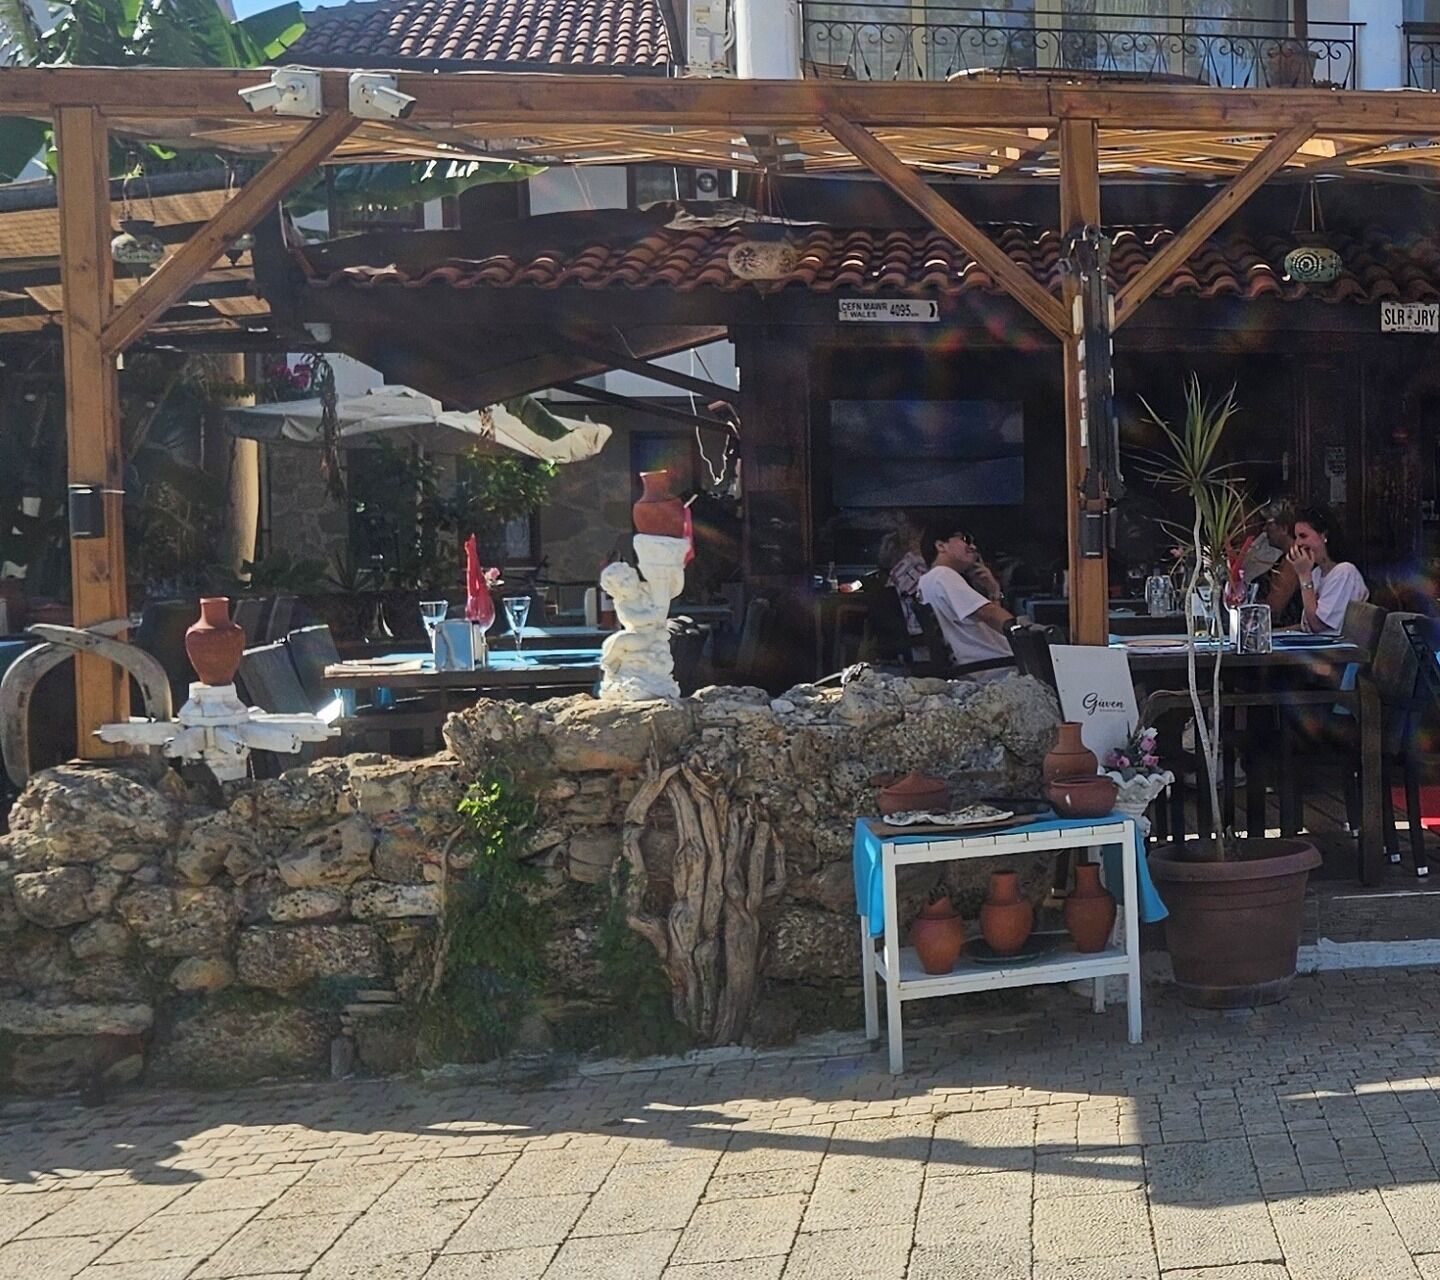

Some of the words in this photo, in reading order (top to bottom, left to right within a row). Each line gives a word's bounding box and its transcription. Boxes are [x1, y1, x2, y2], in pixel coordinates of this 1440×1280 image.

[841, 302, 862, 311] CEFN
[863, 302, 888, 311] MAWR
[890, 303, 912, 317] 4095
[1384, 308, 1405, 326] SLR
[1414, 309, 1436, 326] JRY
